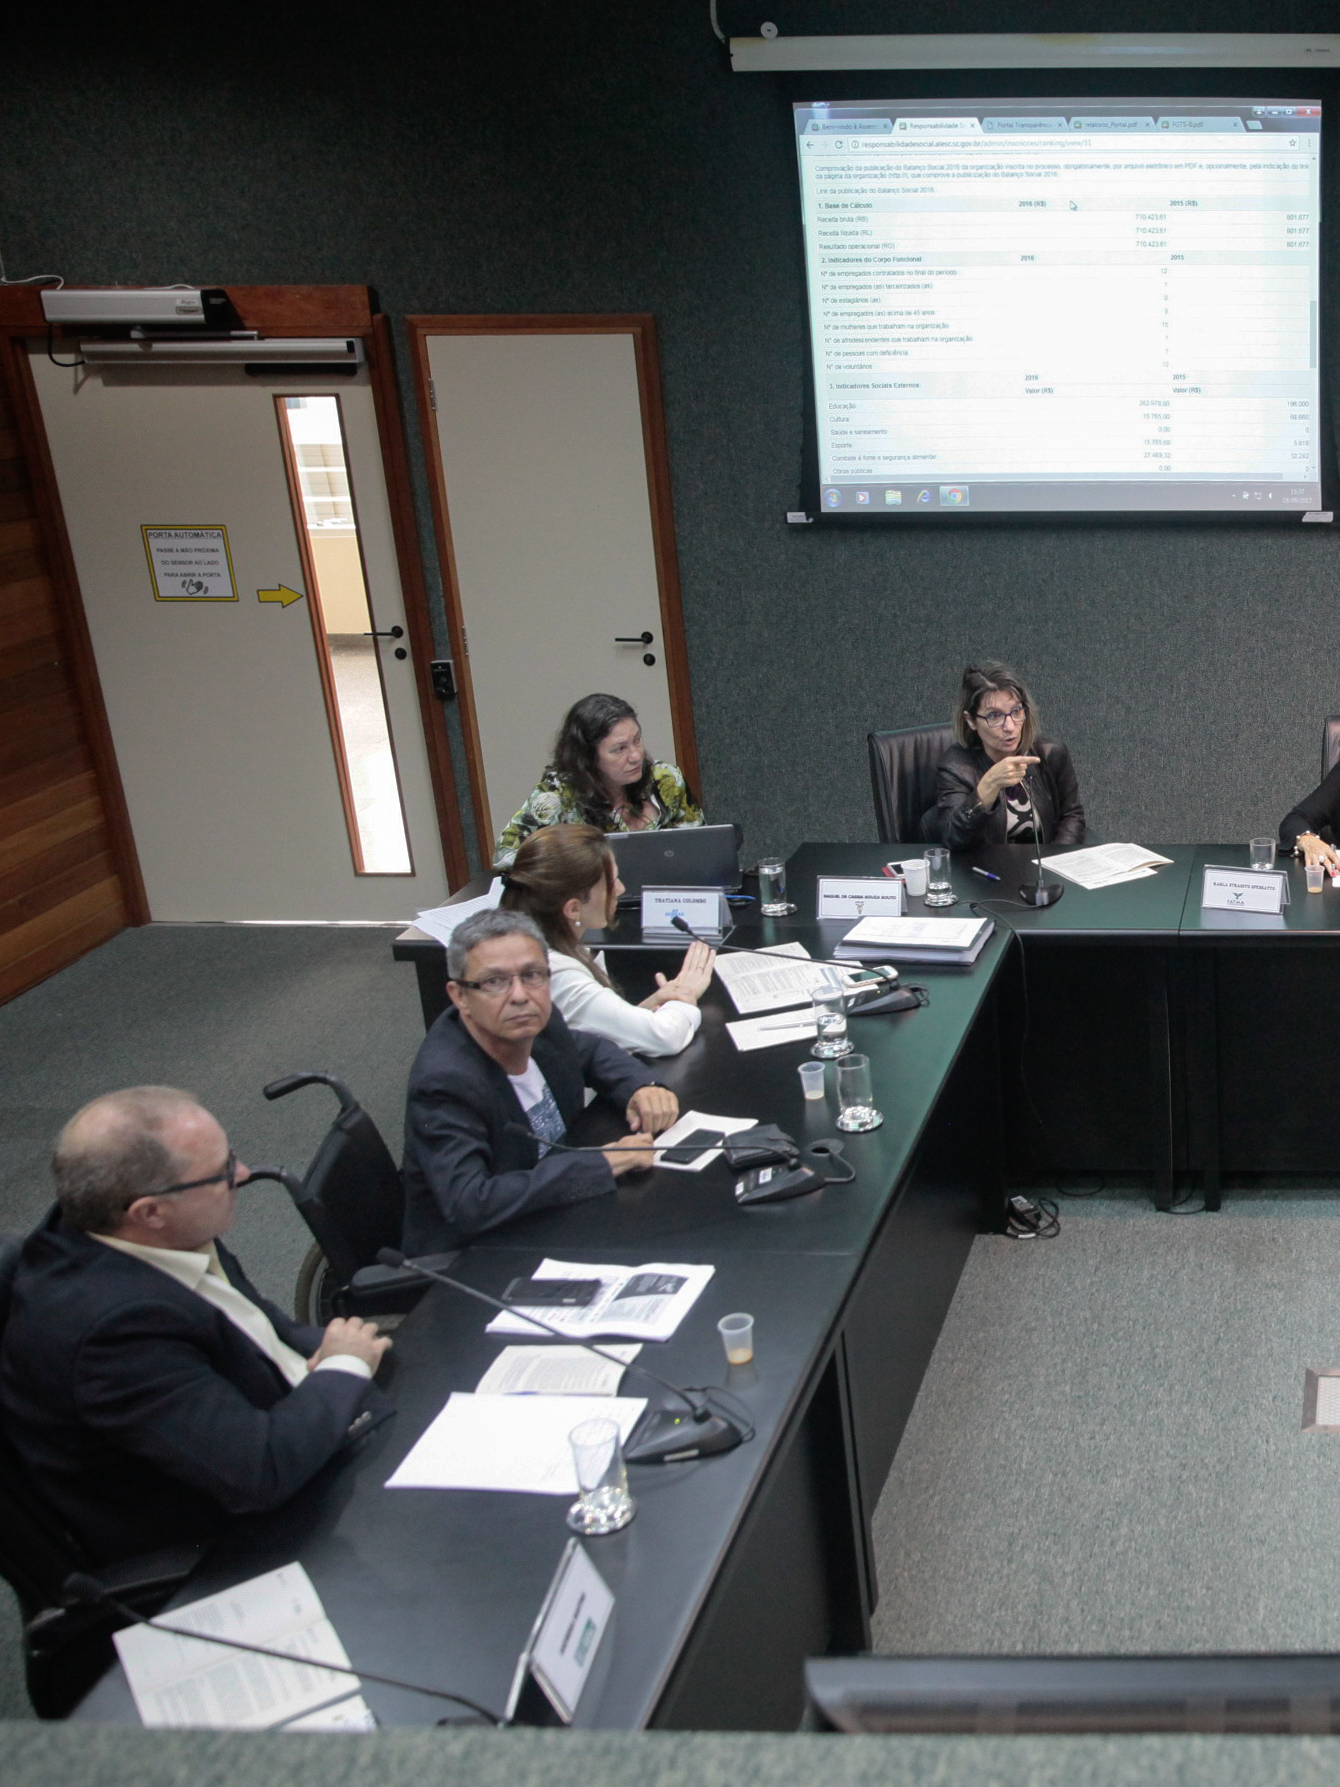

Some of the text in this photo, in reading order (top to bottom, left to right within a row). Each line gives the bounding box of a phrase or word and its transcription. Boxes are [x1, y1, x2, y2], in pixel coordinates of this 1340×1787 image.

[910, 122, 959, 130] Responsabilidade
[1034, 200, 1047, 208] (R$)
[1185, 200, 1198, 208] (R$)
[1041, 387, 1054, 395] (R$)
